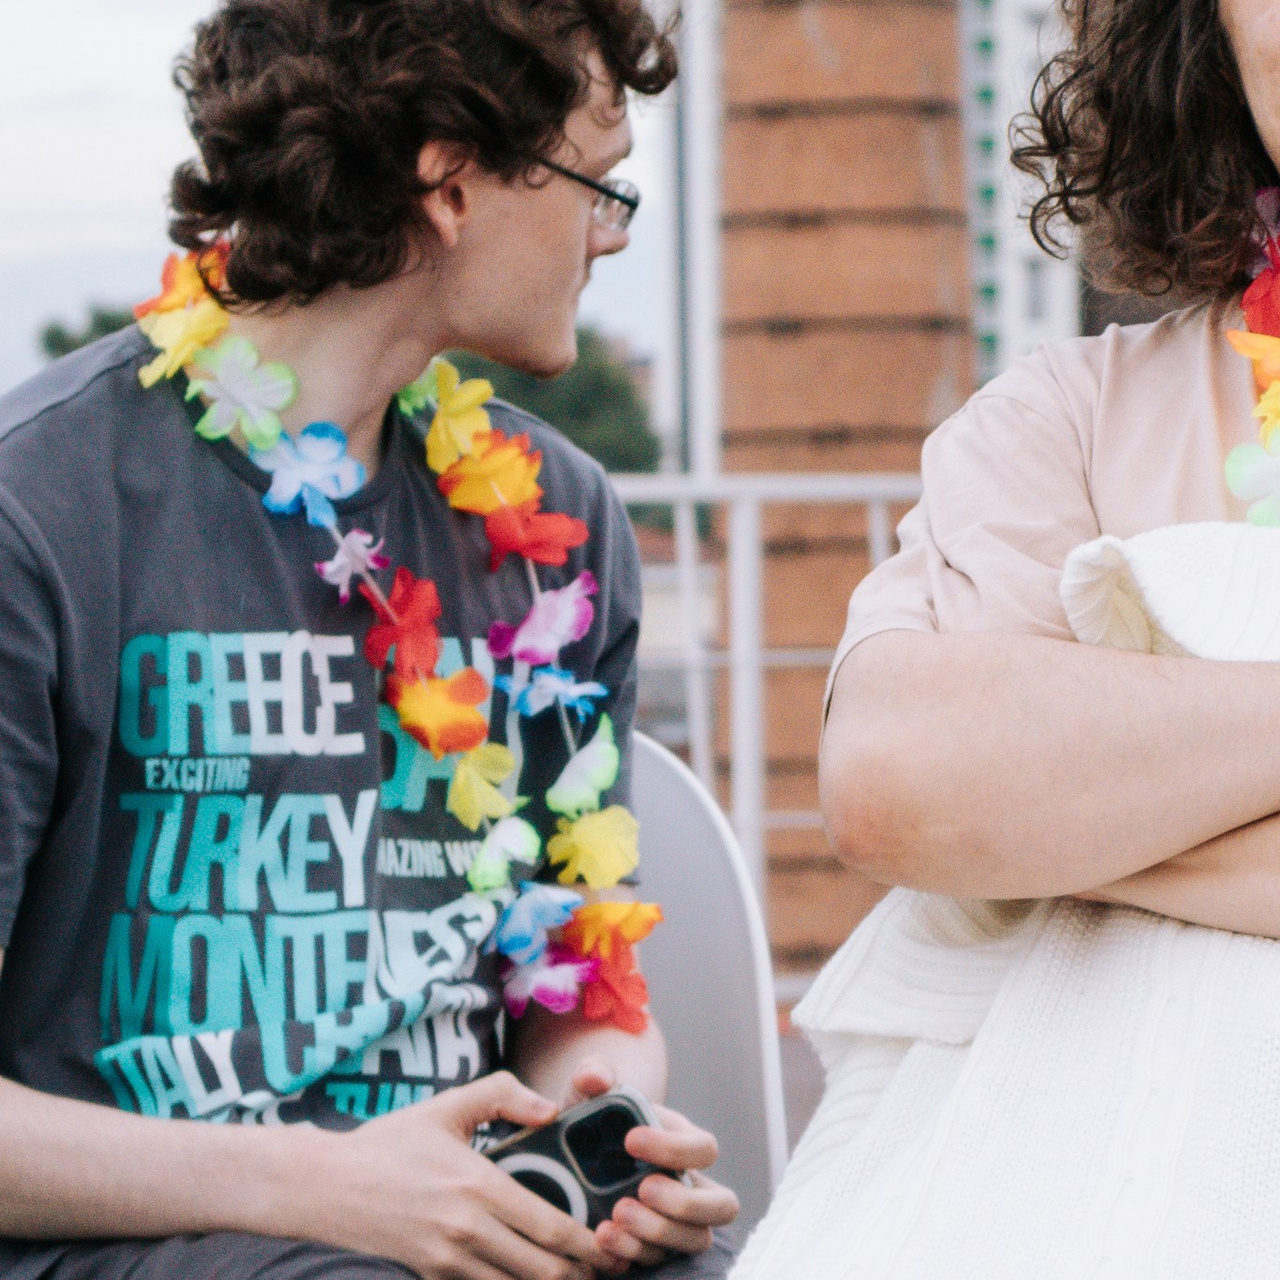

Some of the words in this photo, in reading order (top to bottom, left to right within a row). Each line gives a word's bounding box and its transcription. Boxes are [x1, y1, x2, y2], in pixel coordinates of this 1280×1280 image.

[120, 631, 366, 756] GREECE
[144, 758, 251, 792] EXCITING
[119, 789, 379, 912] TURKEY
[95, 1030, 244, 1119] ITALY
